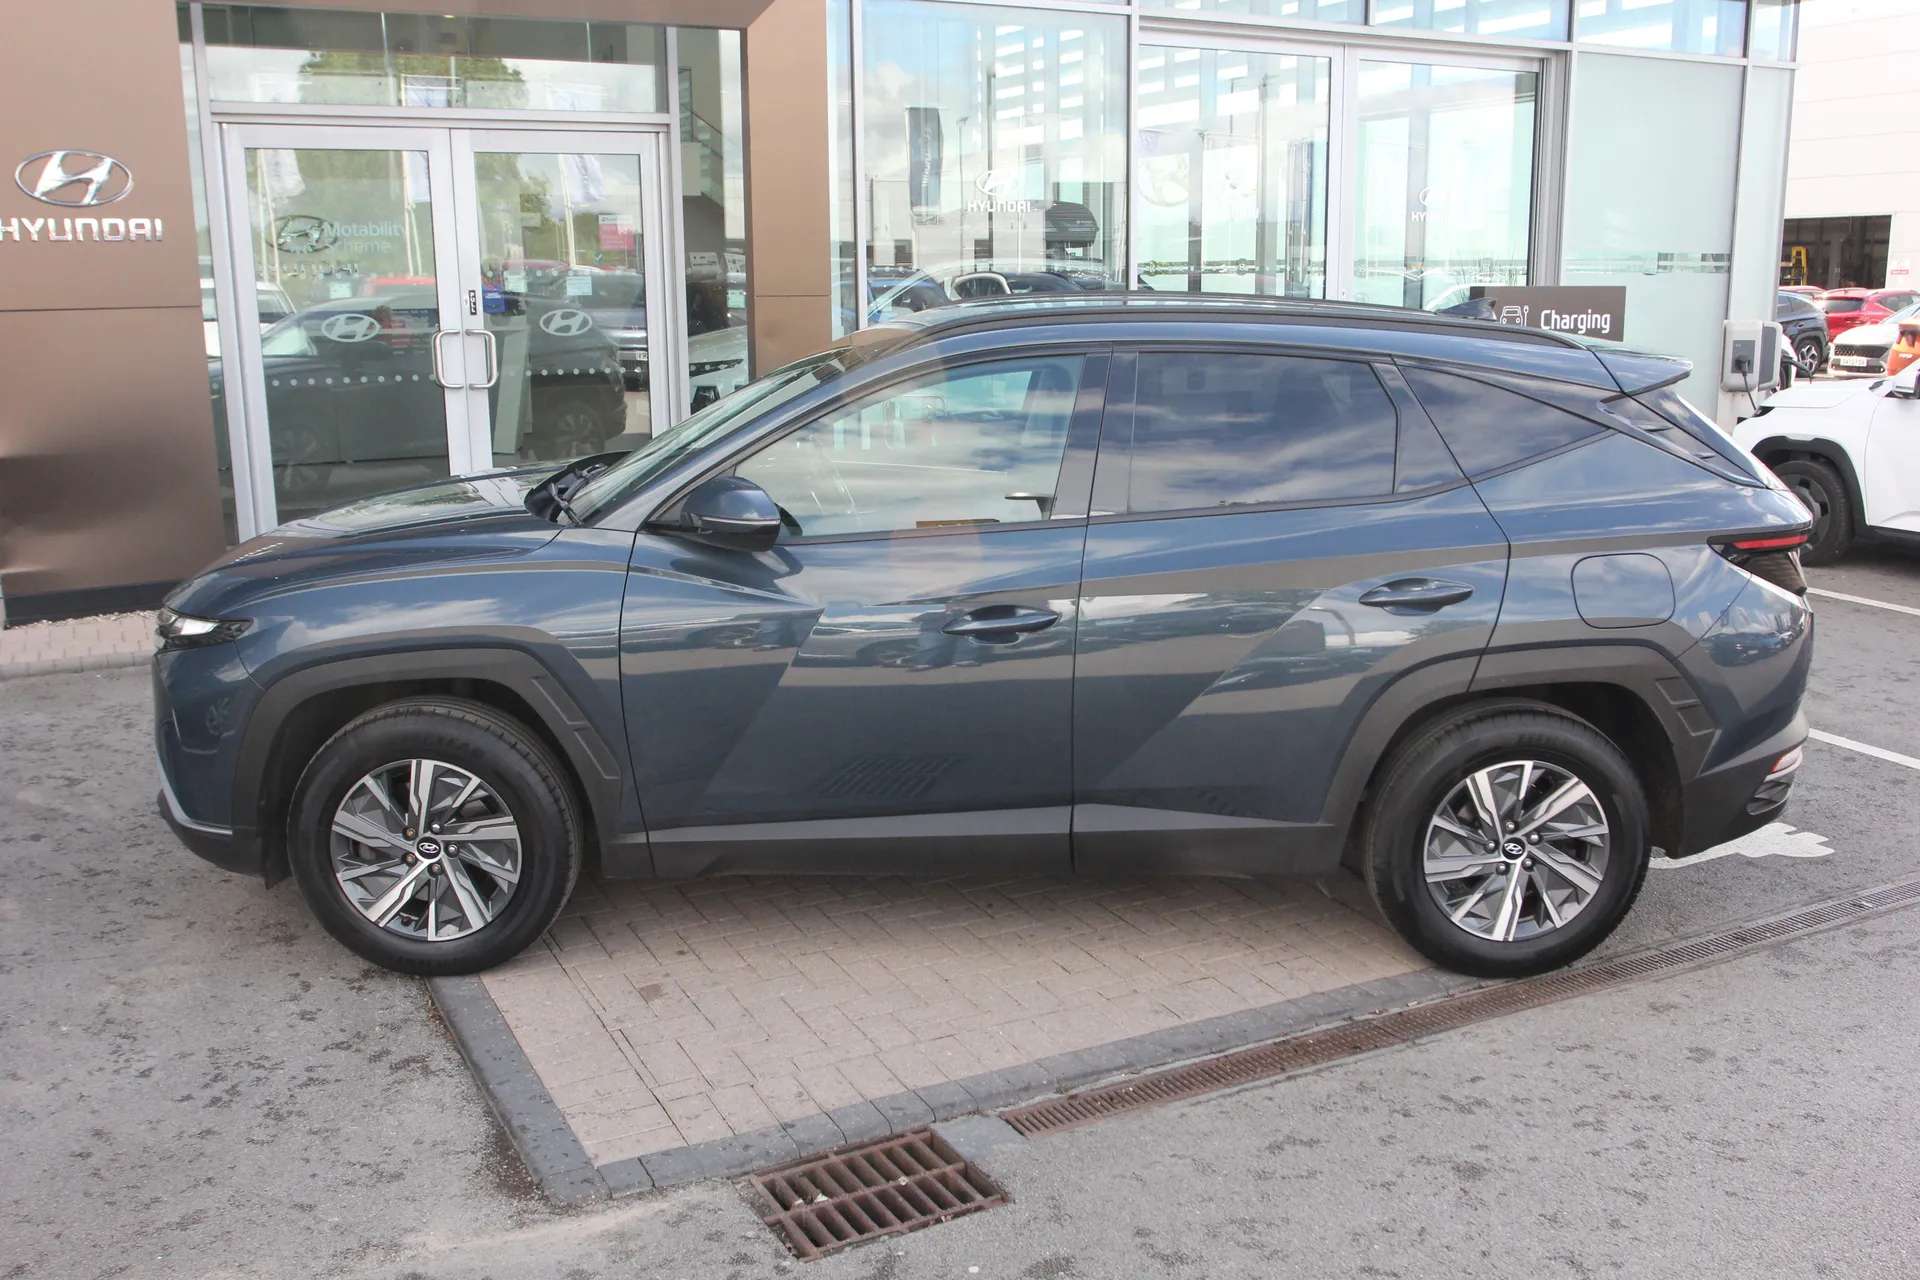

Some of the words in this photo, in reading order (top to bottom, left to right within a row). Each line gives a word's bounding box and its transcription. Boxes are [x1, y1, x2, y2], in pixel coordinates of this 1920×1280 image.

[967, 200, 1031, 213] HYUNDAI
[0, 217, 163, 241] HYUNDAI
[1540, 308, 1611, 334] Charging
